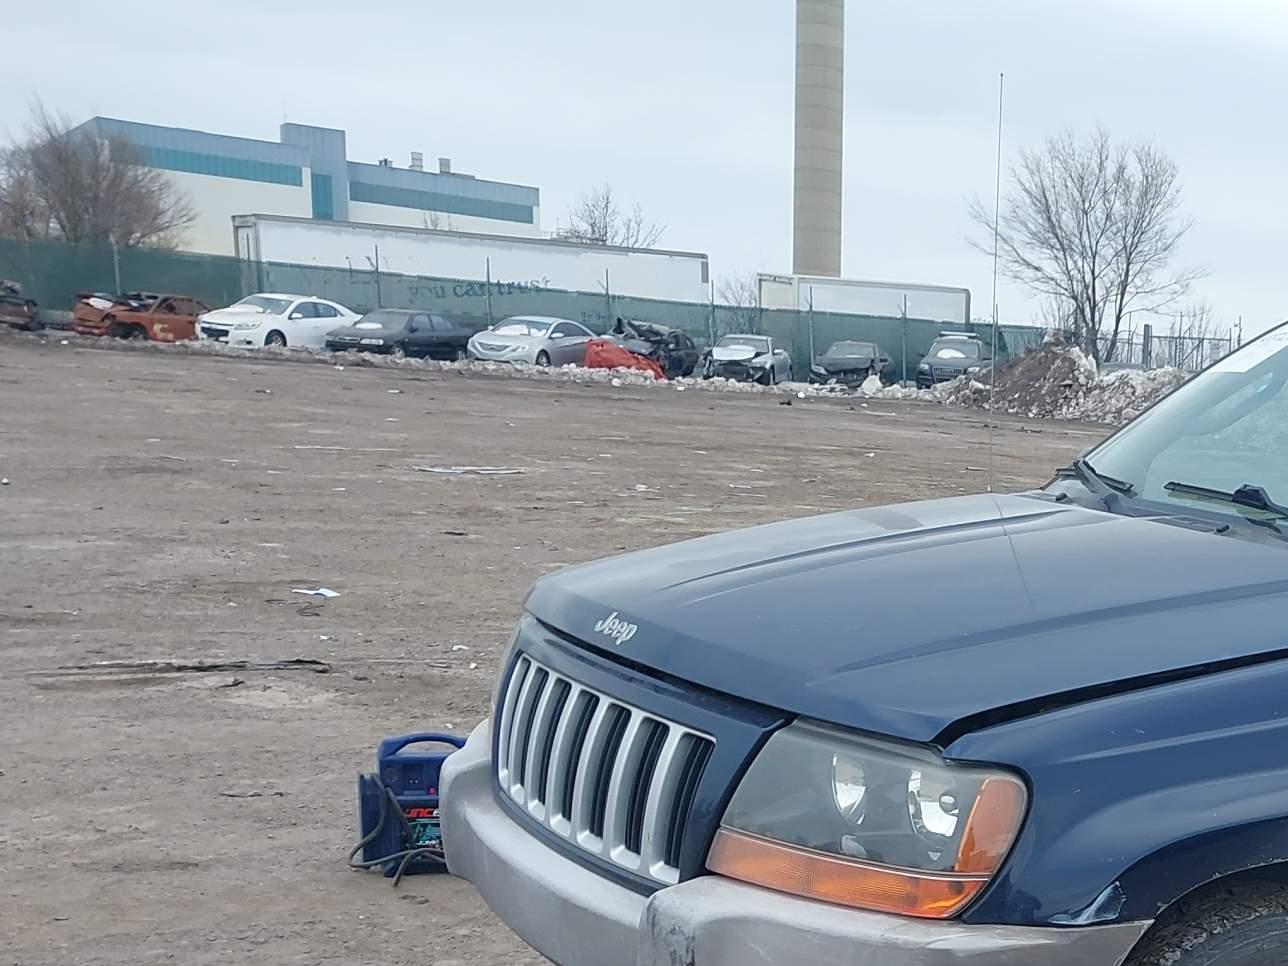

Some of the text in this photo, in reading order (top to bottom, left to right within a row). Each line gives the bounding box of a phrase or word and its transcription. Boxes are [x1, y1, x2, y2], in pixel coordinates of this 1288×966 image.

[453, 281, 494, 297] can
[497, 276, 551, 296] trust
[594, 611, 638, 646] Jeep
